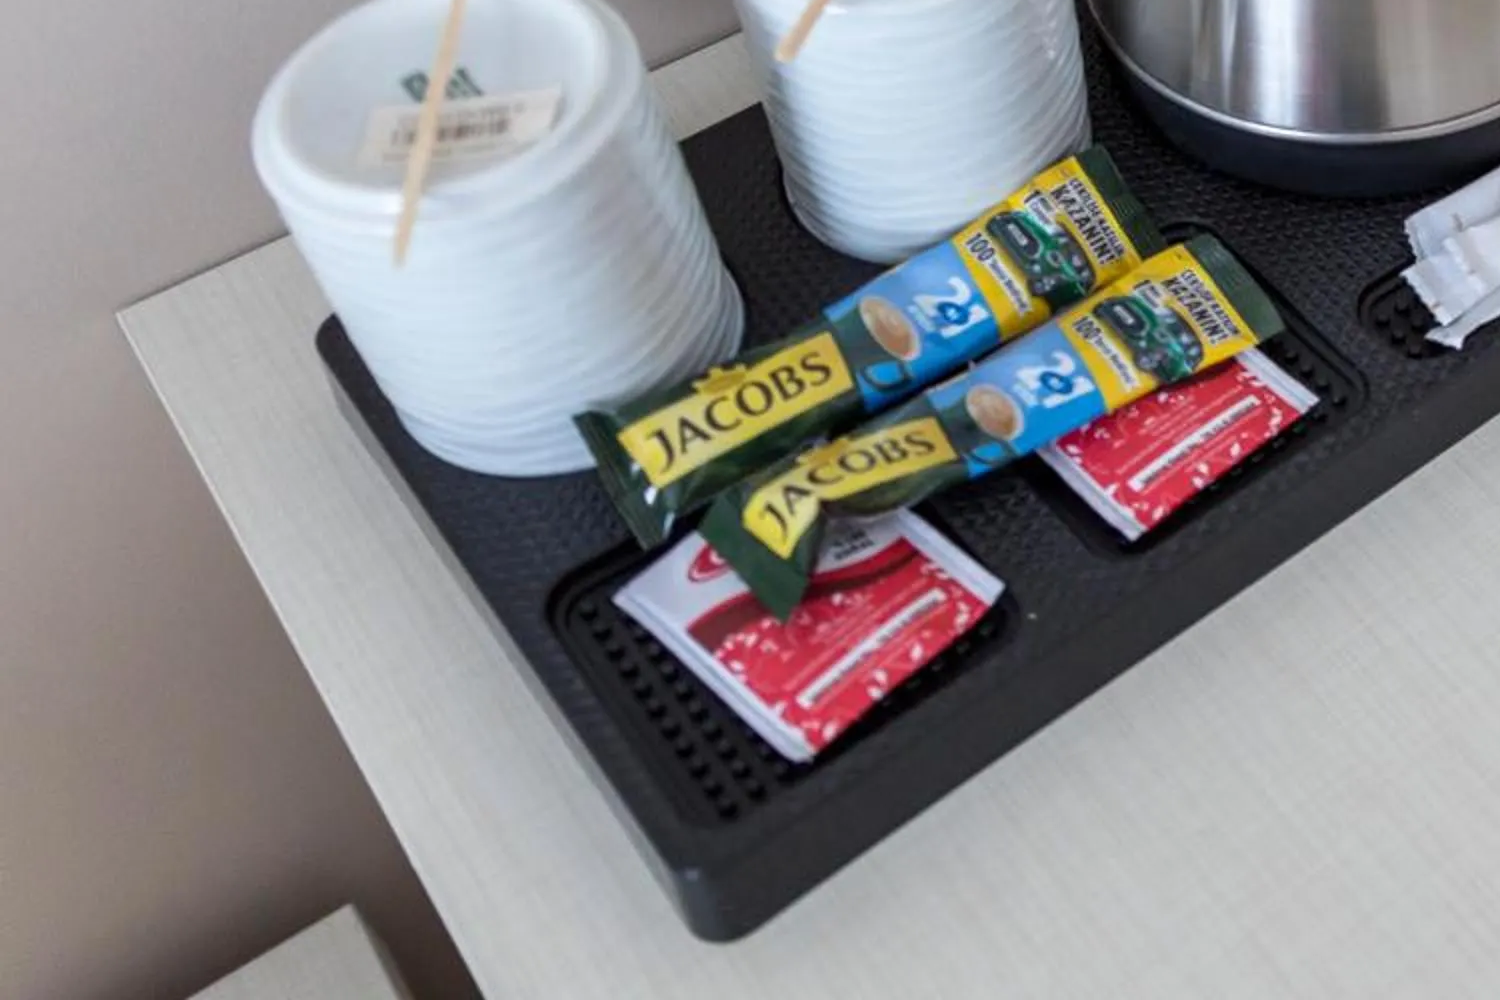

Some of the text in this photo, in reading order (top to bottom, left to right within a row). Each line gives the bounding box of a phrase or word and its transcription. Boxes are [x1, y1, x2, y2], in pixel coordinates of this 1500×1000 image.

[965, 231, 996, 262] 100
[1051, 183, 1118, 265] KAZANIN!
[1160, 277, 1229, 346] KAZANIN!
[646, 351, 833, 474] JACOBS
[758, 430, 937, 545] JACOBS
